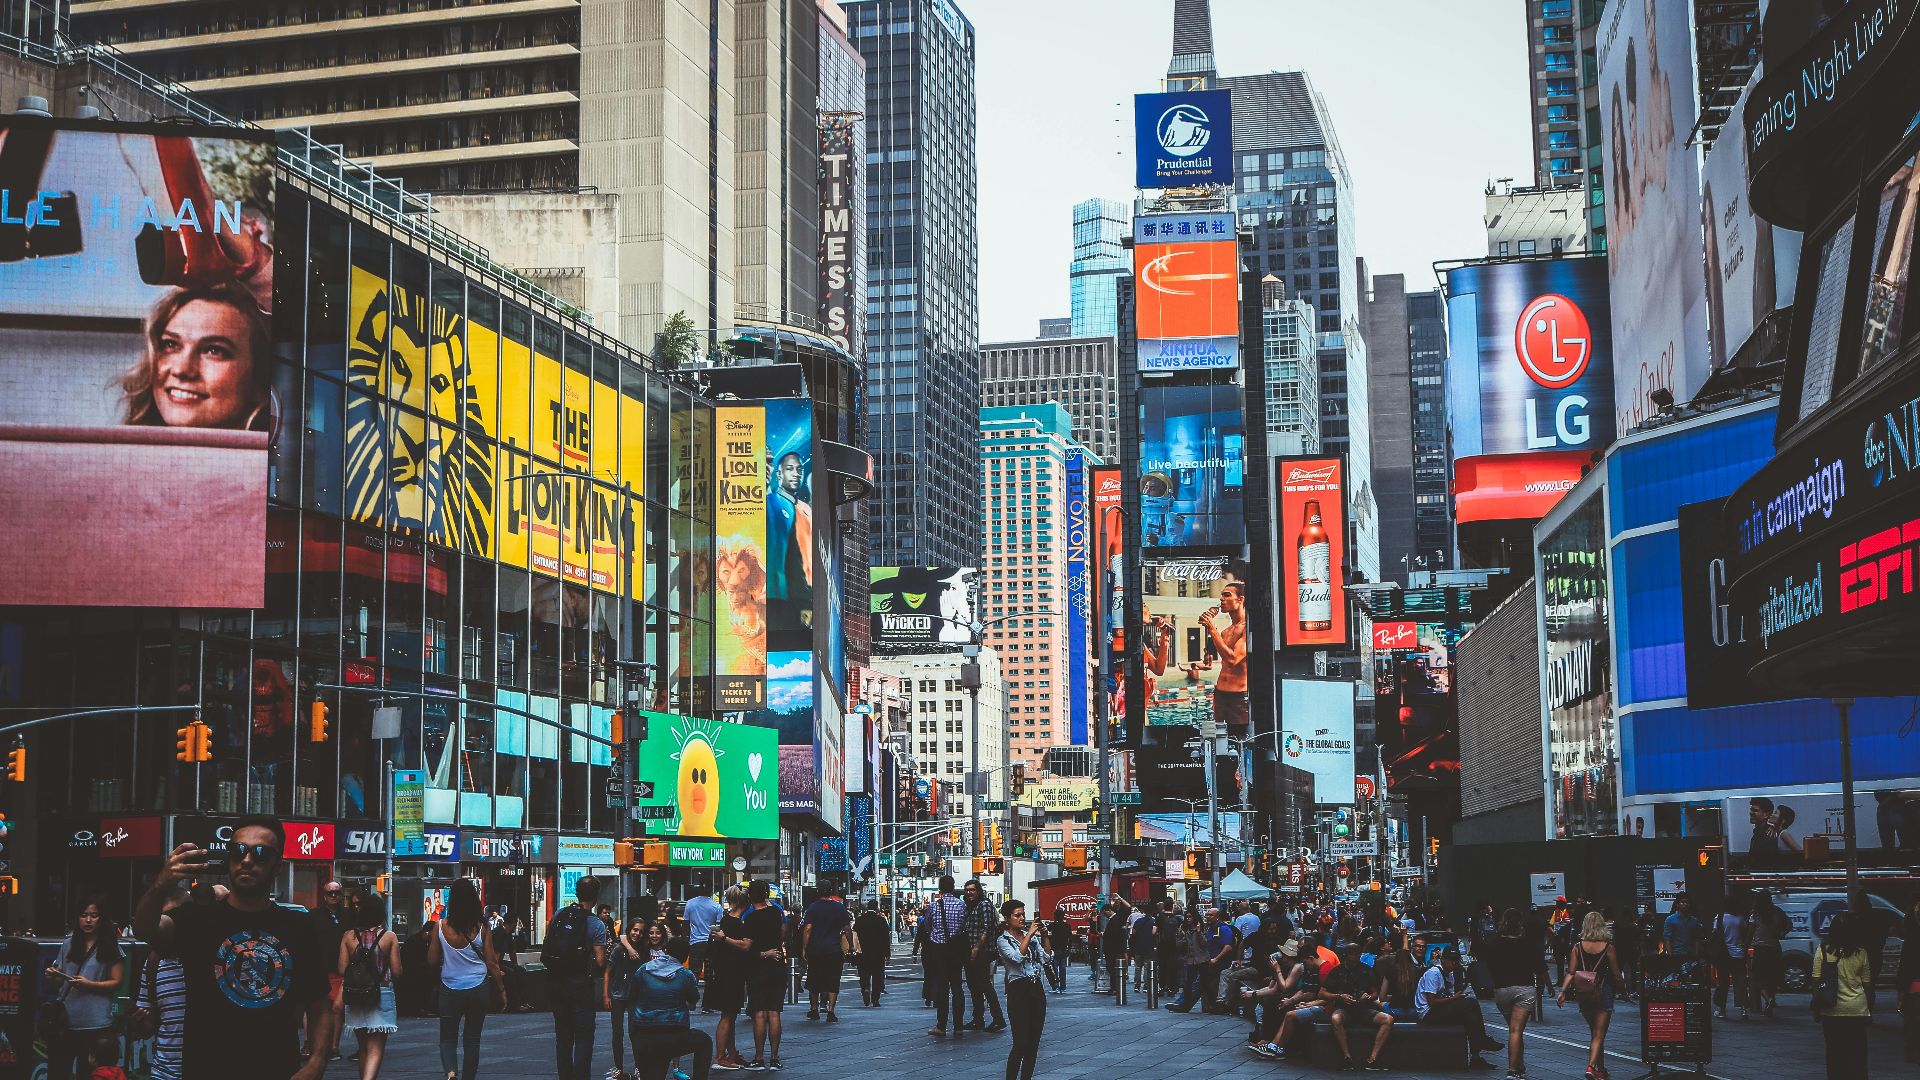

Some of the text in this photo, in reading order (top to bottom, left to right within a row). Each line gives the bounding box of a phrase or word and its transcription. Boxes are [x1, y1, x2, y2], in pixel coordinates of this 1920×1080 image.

[1802, 37, 1851, 108] Night
[1854, 8, 1884, 61] Live
[1156, 156, 1212, 169] Prudential
[92, 192, 243, 236] HAAN
[824, 153, 849, 290] TIMES
[1143, 220, 1226, 237] 新华通讯社
[1159, 342, 1219, 357] XINHUA
[1146, 356, 1232, 368] NEWS AGENCY
[549, 399, 589, 453] THE
[1525, 394, 1591, 450] LG
[727, 441, 752, 454] THE
[722, 456, 758, 479] LION
[1148, 457, 1230, 470] Live beautiful
[508, 436, 571, 536] LION
[719, 479, 763, 505] KING
[1752, 501, 1764, 547] in
[1767, 458, 1845, 536] campaign
[1067, 465, 1086, 562] NOVOTEL
[533, 554, 559, 571] ENTRANCE
[564, 564, 573, 574] ON
[574, 566, 587, 579] 45TH
[880, 613, 931, 630] WICKED
[1375, 624, 1413, 646] Ray-Ban
[1546, 639, 1592, 712] OLD NAVY
[1305, 739, 1350, 749] THE GLOBAL GOALS
[743, 783, 767, 810] YOU
[796, 800, 814, 808] MAD
[1112, 795, 1119, 803] W
[1122, 794, 1132, 802] 44
[643, 808, 651, 818] W
[655, 807, 665, 817] 44
[101, 827, 129, 847] Ray-Ban
[209, 842, 227, 850] OAK
[297, 827, 325, 856] Ray-Ban
[672, 847, 687, 861] NEW
[688, 847, 704, 861] YORK
[1291, 863, 1302, 883] tkts
